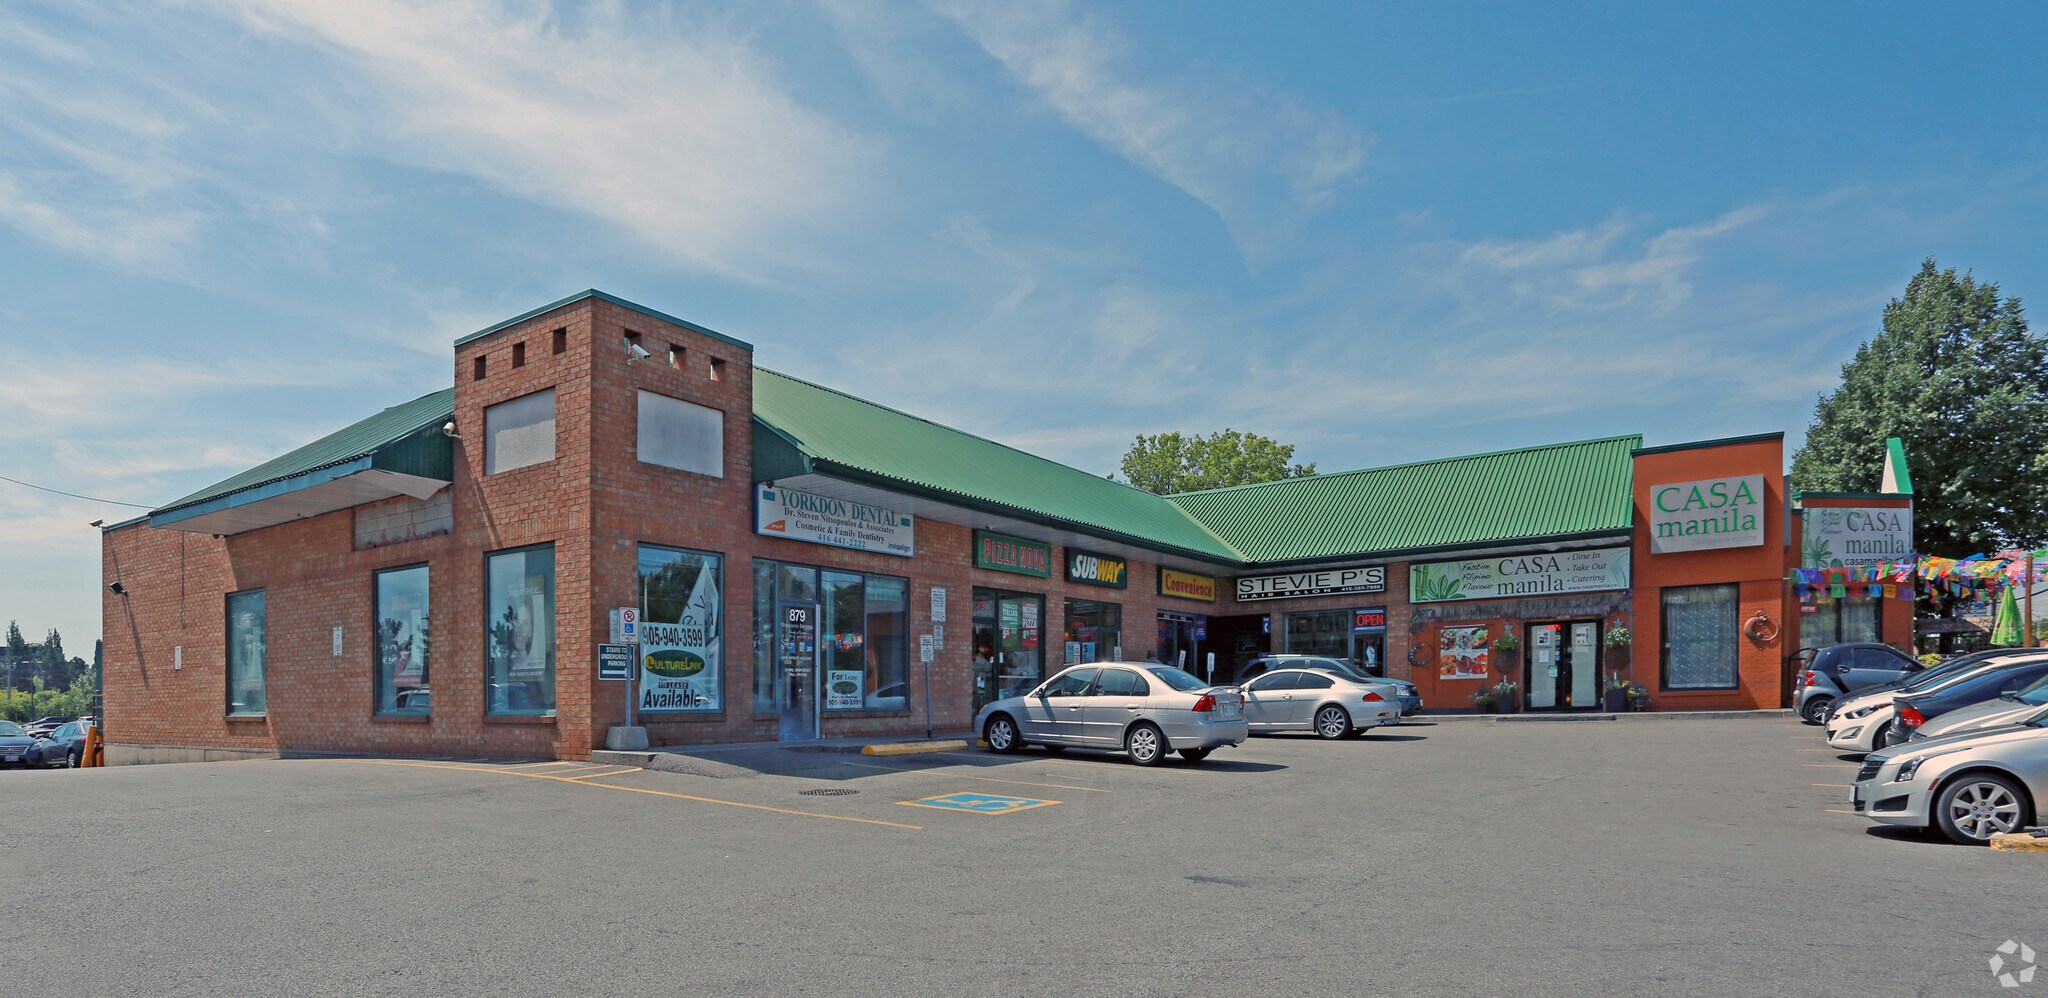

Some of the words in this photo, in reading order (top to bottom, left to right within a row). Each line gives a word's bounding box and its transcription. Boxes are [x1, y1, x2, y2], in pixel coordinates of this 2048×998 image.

[1656, 480, 1758, 513] CASA
[779, 489, 846, 517] YORKDON
[851, 503, 898, 528] DENTAL
[784, 507, 796, 518] Dr.
[797, 509, 819, 522] Steven
[820, 513, 857, 529] Nitsopoulos
[858, 520, 864, 529] &
[865, 523, 895, 535] Associates
[1657, 508, 1758, 539] manila
[1846, 511, 1903, 532] CASA
[795, 520, 826, 533] Cosmetic
[827, 526, 833, 534] &
[835, 527, 856, 540] Family
[857, 531, 885, 544] Dentistry
[817, 534, 831, 543] 416
[833, 537, 866, 548] 441-2222
[888, 541, 911, 554] invisalign
[1845, 534, 1905, 554] manila
[984, 538, 1016, 566] PIZZA
[1019, 546, 1046, 572] NOVA
[1572, 552, 1592, 561] Dine
[1593, 552, 1601, 560] In
[1071, 554, 1124, 583] SUBWAY
[1461, 563, 1490, 572] Festive
[1498, 556, 1562, 577] CASA
[1572, 563, 1591, 572] Take
[1592, 562, 1607, 571] Out
[1165, 573, 1213, 597] Convenience
[1239, 573, 1331, 593] STEVIE
[1341, 569, 1383, 586] P'S
[1461, 573, 1491, 582] Filipino
[1496, 574, 1564, 596] manila
[1571, 574, 1605, 584] Catering
[1284, 587, 1332, 596] SALON
[1461, 582, 1494, 591] Flavour
[1568, 583, 1618, 591] www.casamanila.ca
[789, 609, 806, 622] 879
[1002, 608, 1018, 616] ITALIAN
[1356, 614, 1384, 627] OPEN
[1022, 619, 1037, 628] PIZZA
[642, 626, 703, 647] 905-940-3599
[832, 672, 843, 680] For
[643, 689, 701, 709] Available
